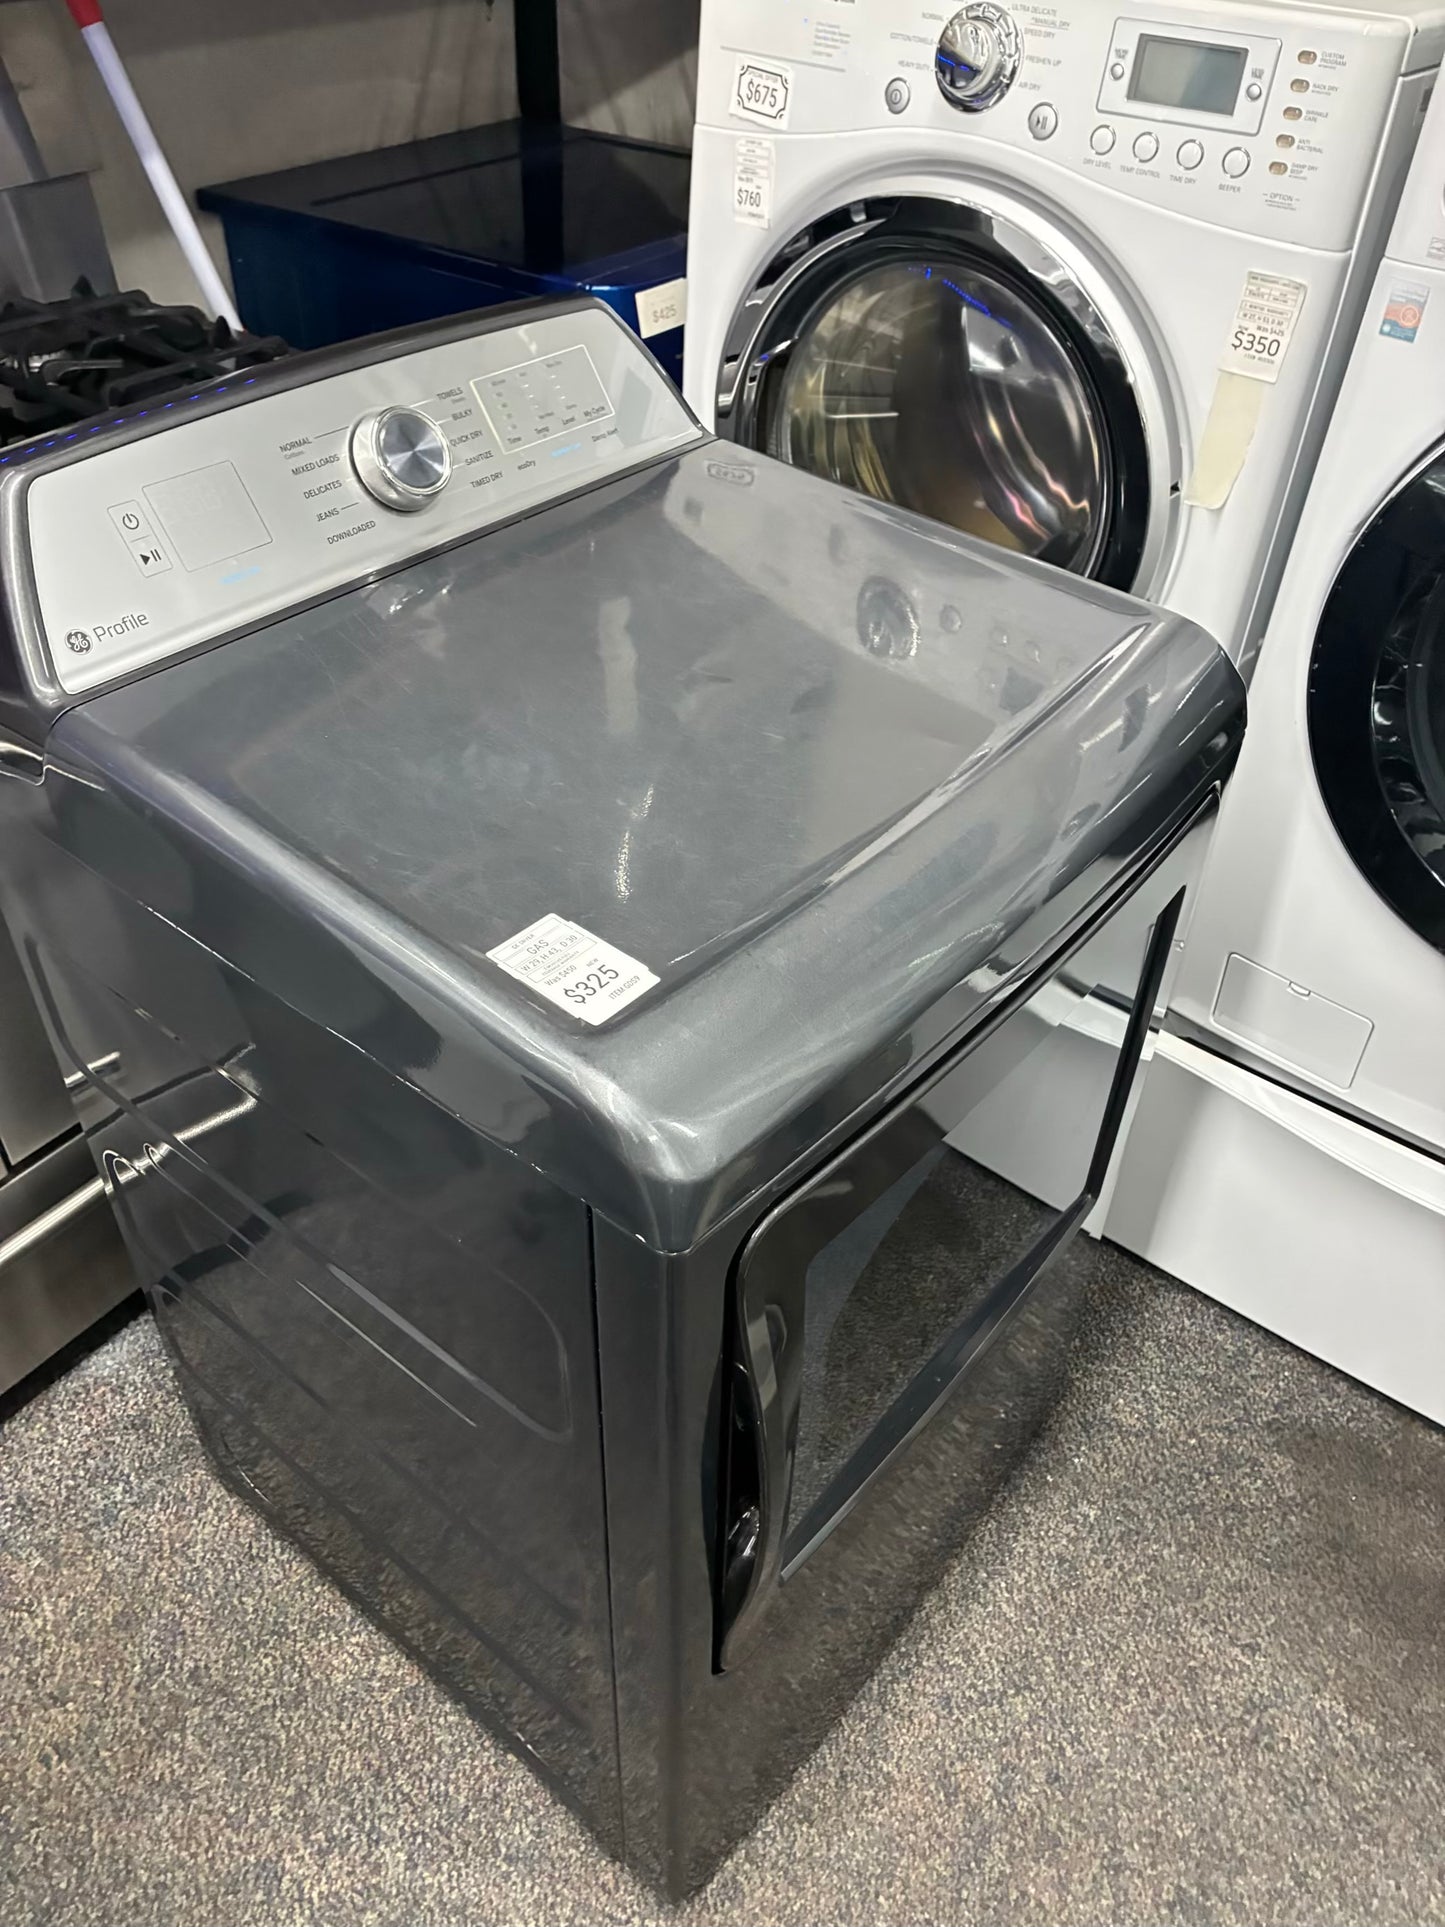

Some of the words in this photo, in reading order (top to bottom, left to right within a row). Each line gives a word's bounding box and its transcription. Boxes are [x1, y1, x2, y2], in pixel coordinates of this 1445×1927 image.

[1012, 4, 1030, 12] ULTRA
[1031, 6, 1057, 16] DELICATE
[1024, 27, 1042, 37] SPEED
[1043, 31, 1055, 39] DRY
[1026, 55, 1051, 65] FRESHEN
[1053, 59, 1062, 67] UP
[1320, 58, 1347, 66] PROGRAM
[1322, 51, 1345, 59] CUSTOM
[1018, 81, 1028, 89] AIR
[1029, 83, 1041, 91] DRY
[746, 80, 778, 108] $675
[1296, 145, 1323, 154] BACTERIAL
[1083, 157, 1094, 166] DRY
[1095, 159, 1112, 170] LEVEL
[1120, 165, 1135, 174] TEMP
[1136, 167, 1160, 178] CONTROL
[1169, 175, 1183, 183] TIME
[1219, 183, 1241, 193] BEEPER
[737, 188, 761, 207] $760
[1270, 192, 1293, 202] OPTION
[653, 304, 676, 323] $425
[1231, 330, 1280, 357] $350
[437, 387, 463, 401] TOWELS
[452, 408, 472, 421] BULKY
[561, 416, 576, 425] Level
[535, 426, 550, 435] Temp
[279, 437, 312, 452] NORMAL
[450, 434, 469, 448] QUICK
[469, 430, 483, 441] DRY
[292, 461, 316, 476] MIXED
[316, 454, 340, 469] LOADS
[465, 450, 493, 466] SANITIZE
[517, 459, 536, 471] ecoDry
[470, 475, 491, 488] TIMED
[490, 471, 503, 482] DRY
[304, 480, 342, 499] DELICATES
[316, 507, 340, 522] JEANS
[327, 520, 376, 545] DOWNLOADED
[93, 614, 149, 642] Profile
[526, 939, 549, 955] GAS
[540, 953, 550, 961] H
[566, 935, 578, 944] 30
[544, 976, 561, 986] Was
[558, 964, 577, 978] $450
[563, 964, 619, 1004] $325
[608, 986, 625, 1000] ITEM
